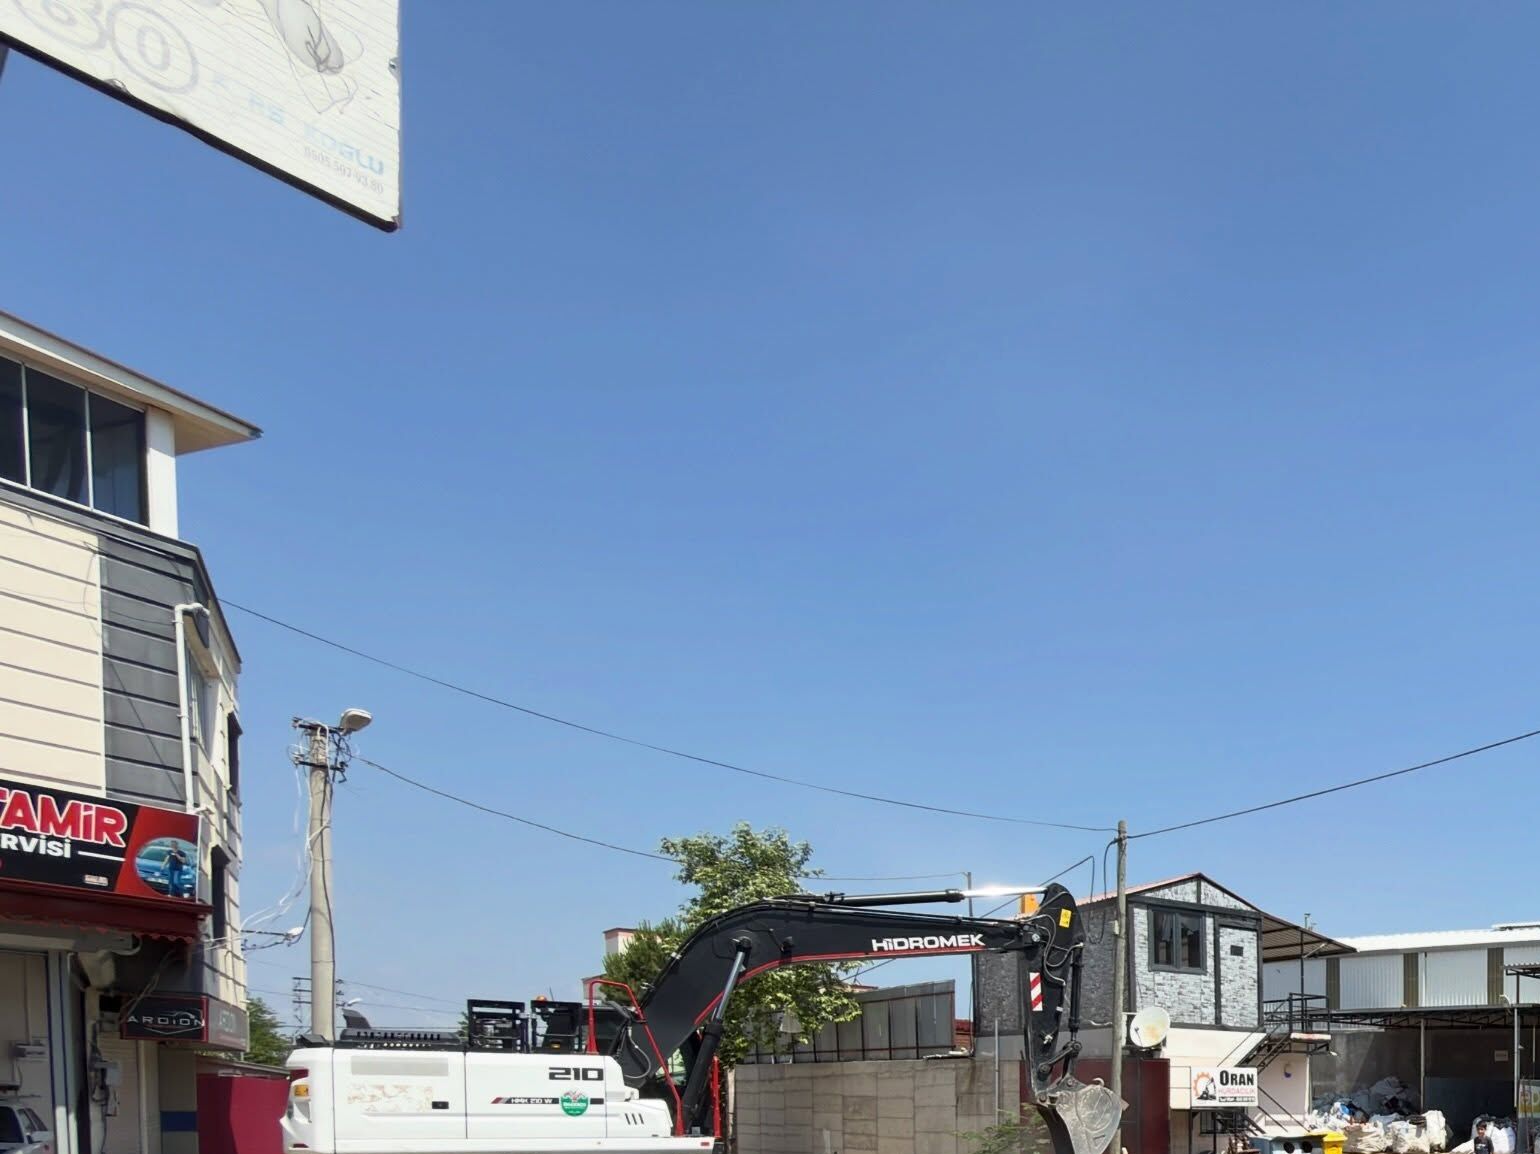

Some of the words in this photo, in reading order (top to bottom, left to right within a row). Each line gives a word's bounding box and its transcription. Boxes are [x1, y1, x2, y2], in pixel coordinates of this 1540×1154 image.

[0, 787, 128, 848] AMİR
[548, 1067, 604, 1081] 210
[1219, 1070, 1255, 1086] ORAN
